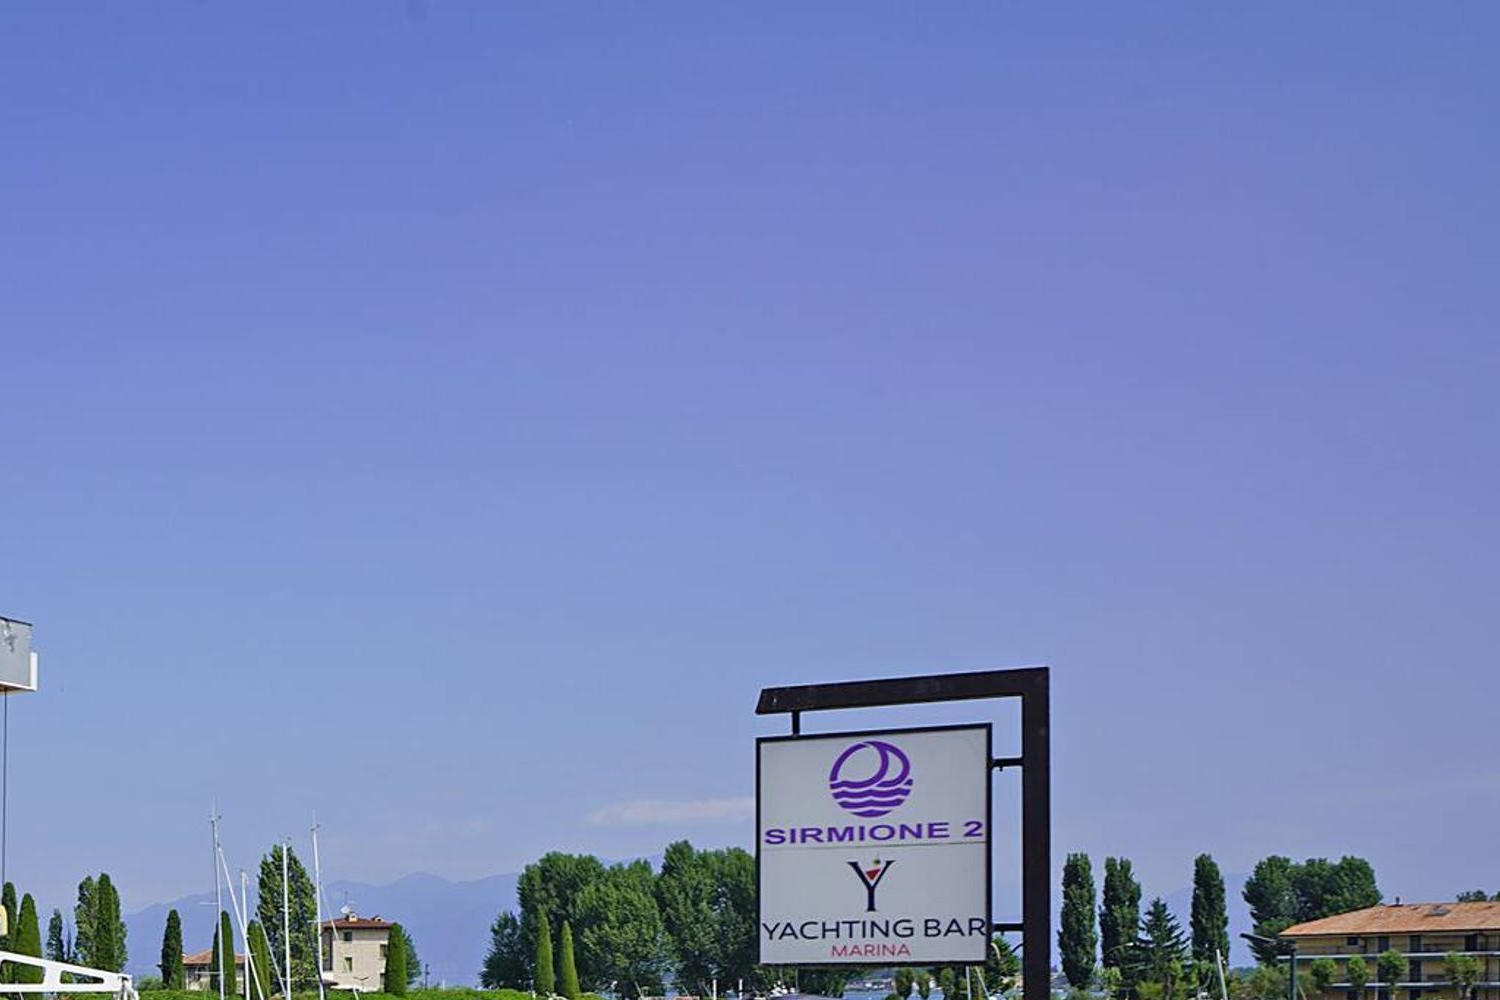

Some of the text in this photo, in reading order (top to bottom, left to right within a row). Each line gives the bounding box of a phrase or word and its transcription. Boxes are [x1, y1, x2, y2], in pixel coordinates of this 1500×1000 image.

[764, 821, 983, 845] SIRMIONE 2
[847, 860, 896, 912] Y
[762, 918, 986, 941] YACHTING BAR
[831, 944, 911, 958] MARINA
